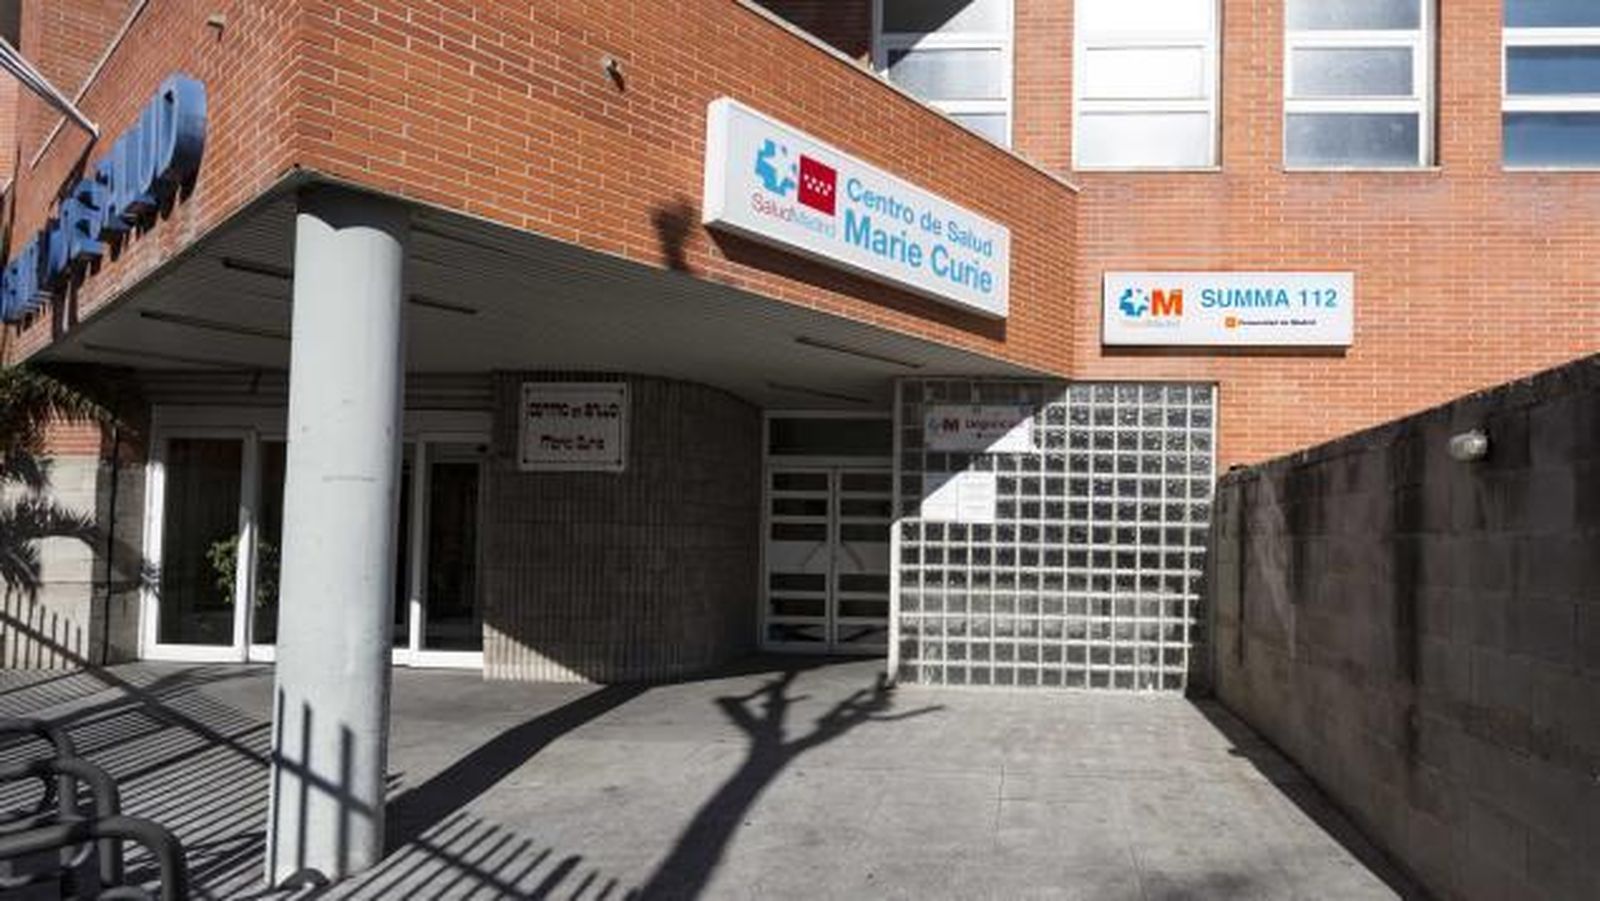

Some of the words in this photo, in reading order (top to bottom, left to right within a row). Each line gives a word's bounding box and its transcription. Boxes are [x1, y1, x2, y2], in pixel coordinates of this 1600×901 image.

[846, 177, 915, 225] Centro
[920, 210, 942, 236] de
[947, 220, 993, 257] Salud
[843, 207, 923, 268] Marie
[931, 243, 993, 294] Curie
[1151, 288, 1183, 317] M
[1200, 288, 1291, 308] SUMMA
[1300, 288, 1338, 308] 112
